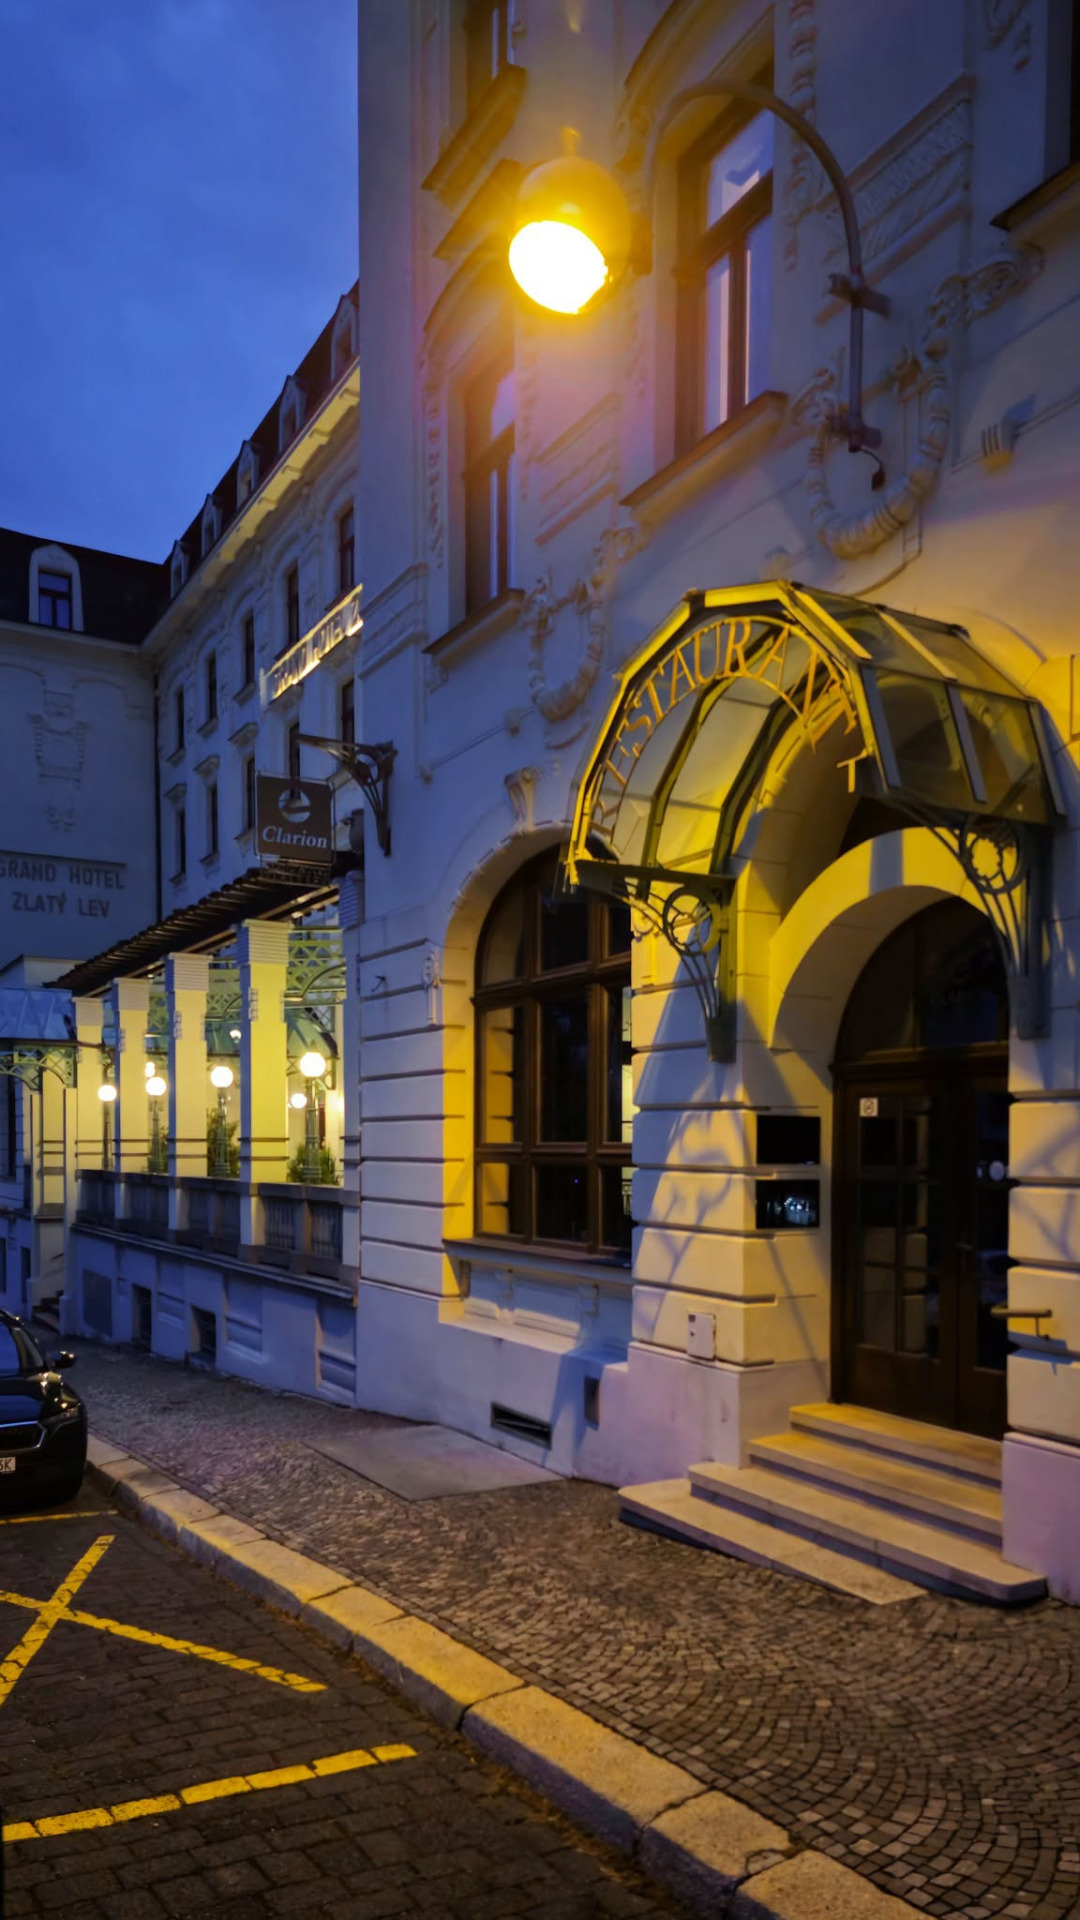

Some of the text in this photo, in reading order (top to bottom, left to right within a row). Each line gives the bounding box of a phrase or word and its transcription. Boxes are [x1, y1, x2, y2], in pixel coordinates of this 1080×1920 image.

[262, 825, 328, 849] Clarion
[0, 860, 127, 889] GRAND HOTEL
[11, 890, 110, 918] ZLATÝ LEV
